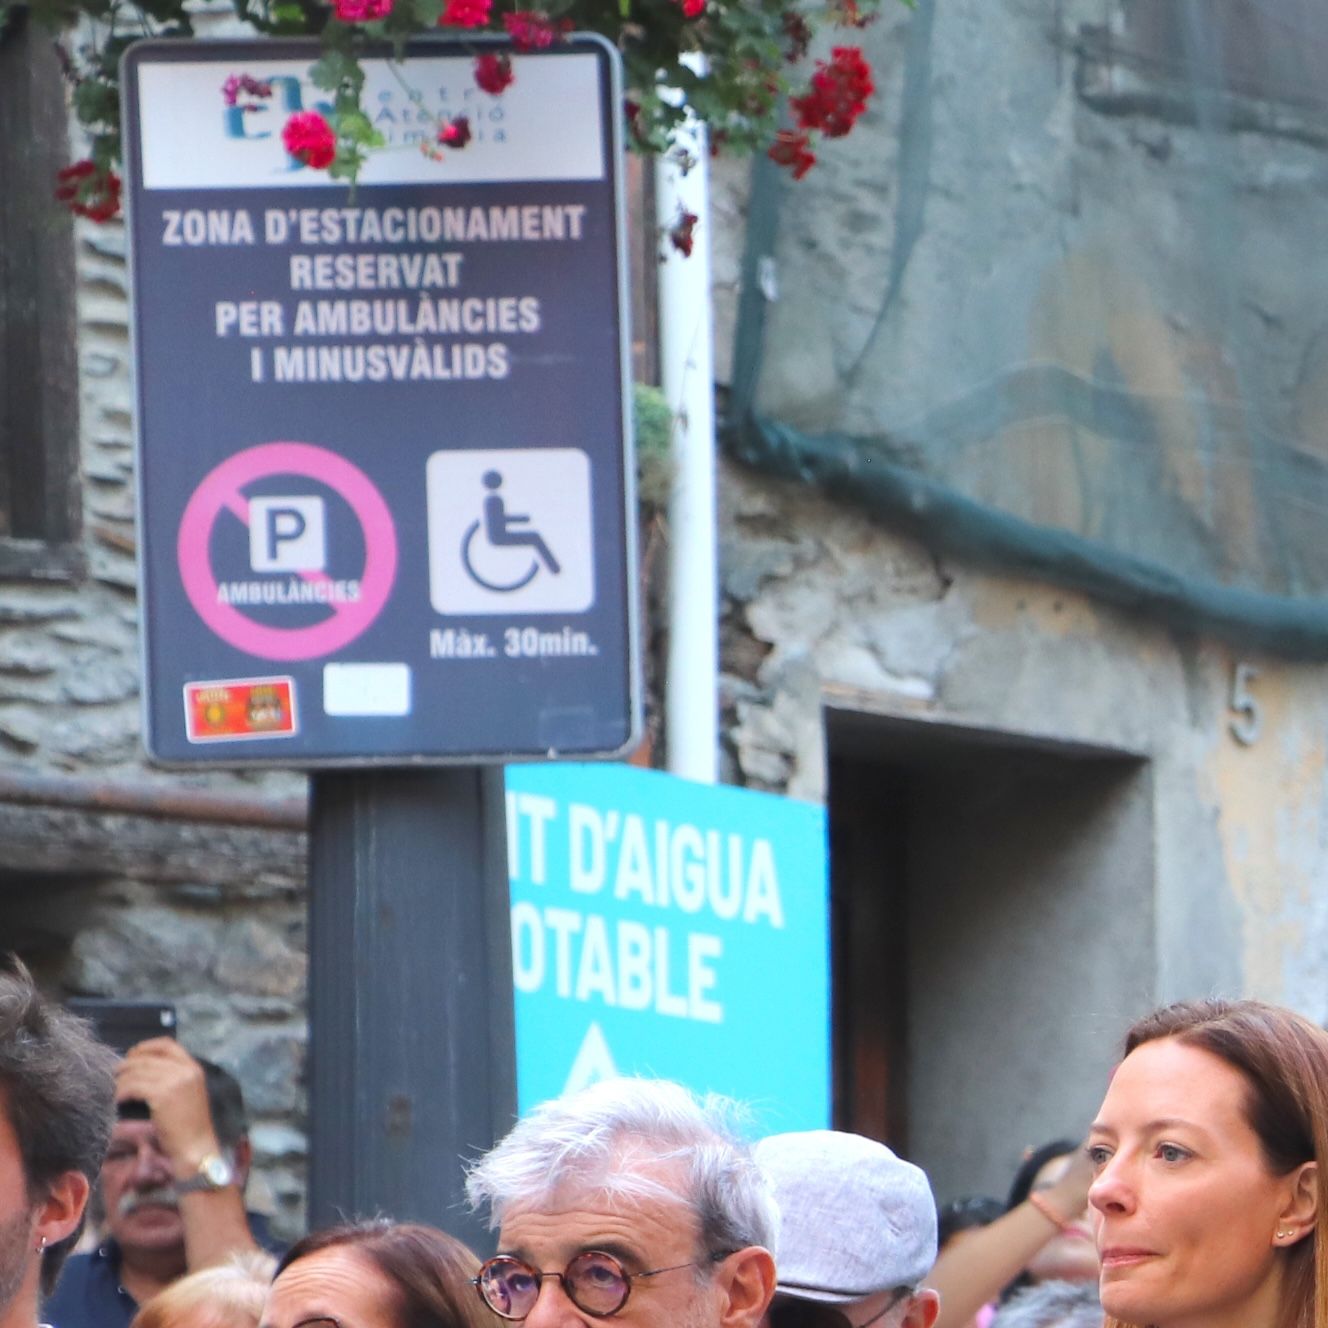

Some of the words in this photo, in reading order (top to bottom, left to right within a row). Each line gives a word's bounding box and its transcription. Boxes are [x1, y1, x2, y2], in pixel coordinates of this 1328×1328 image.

[162, 209, 255, 246] ZONA
[264, 205, 585, 245] D'ESTACIONAMENT
[289, 253, 463, 290] RESERVAT
[215, 301, 284, 337] PER
[293, 290, 541, 336] AMBULÀNCIES
[251, 347, 263, 382] I
[273, 338, 509, 382] MINUSVÀLIDS
[267, 508, 306, 560] P
[217, 576, 360, 605] AMBULÀNCIES
[429, 629, 495, 658] Màx.
[504, 627, 598, 657] 30min.
[1227, 663, 1261, 746] 5
[568, 803, 785, 929] D'AIGUA
[511, 902, 724, 1024] OTABLE
